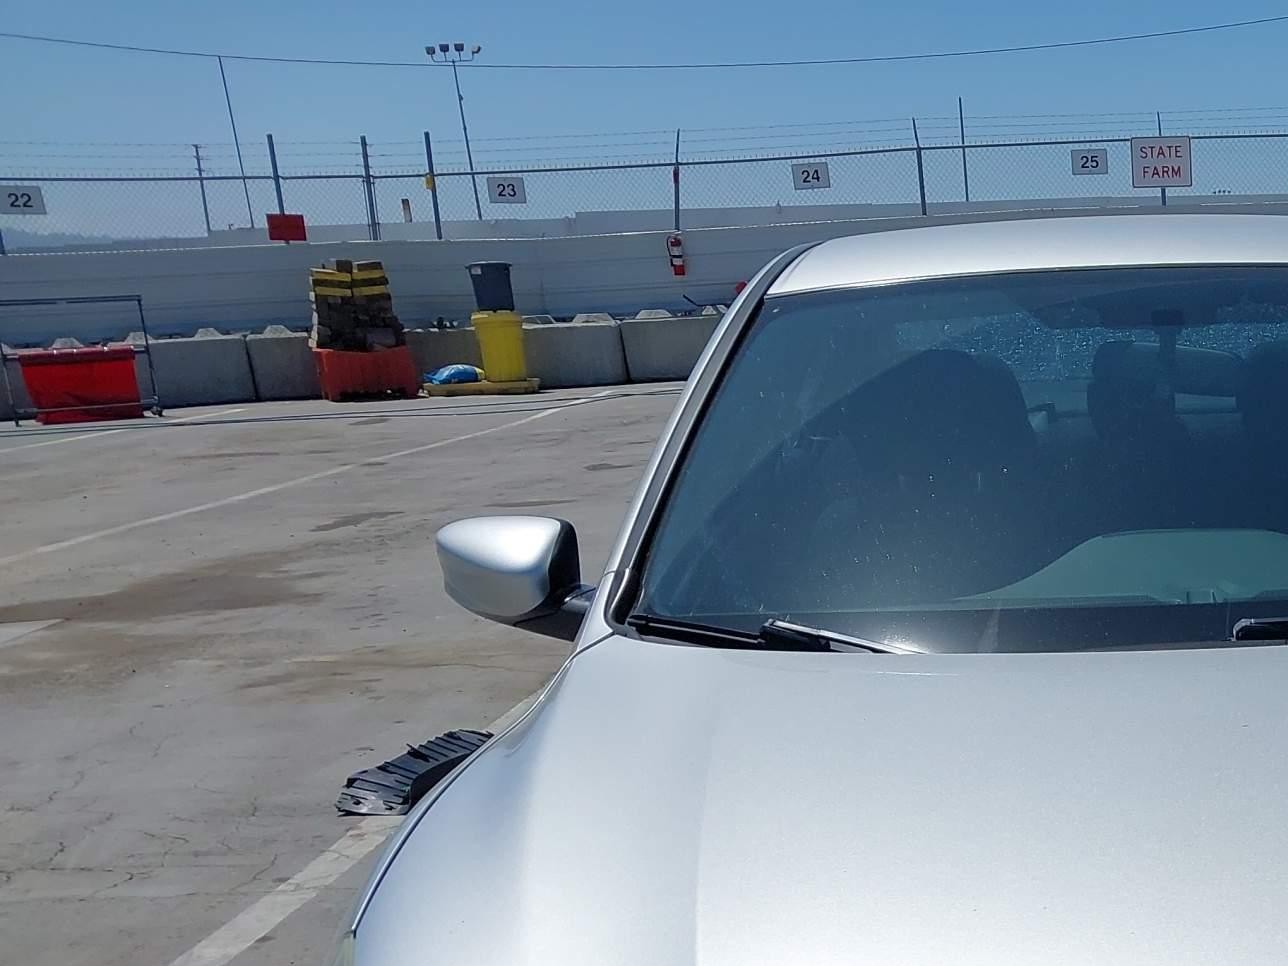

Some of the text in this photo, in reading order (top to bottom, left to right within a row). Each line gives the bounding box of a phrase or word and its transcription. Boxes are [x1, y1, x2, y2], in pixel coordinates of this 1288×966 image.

[1139, 145, 1183, 159] STATE
[1080, 155, 1099, 169] 25
[801, 169, 821, 183] 24
[1142, 165, 1182, 178] FARM
[496, 183, 517, 197] 23
[7, 192, 33, 208] 22
